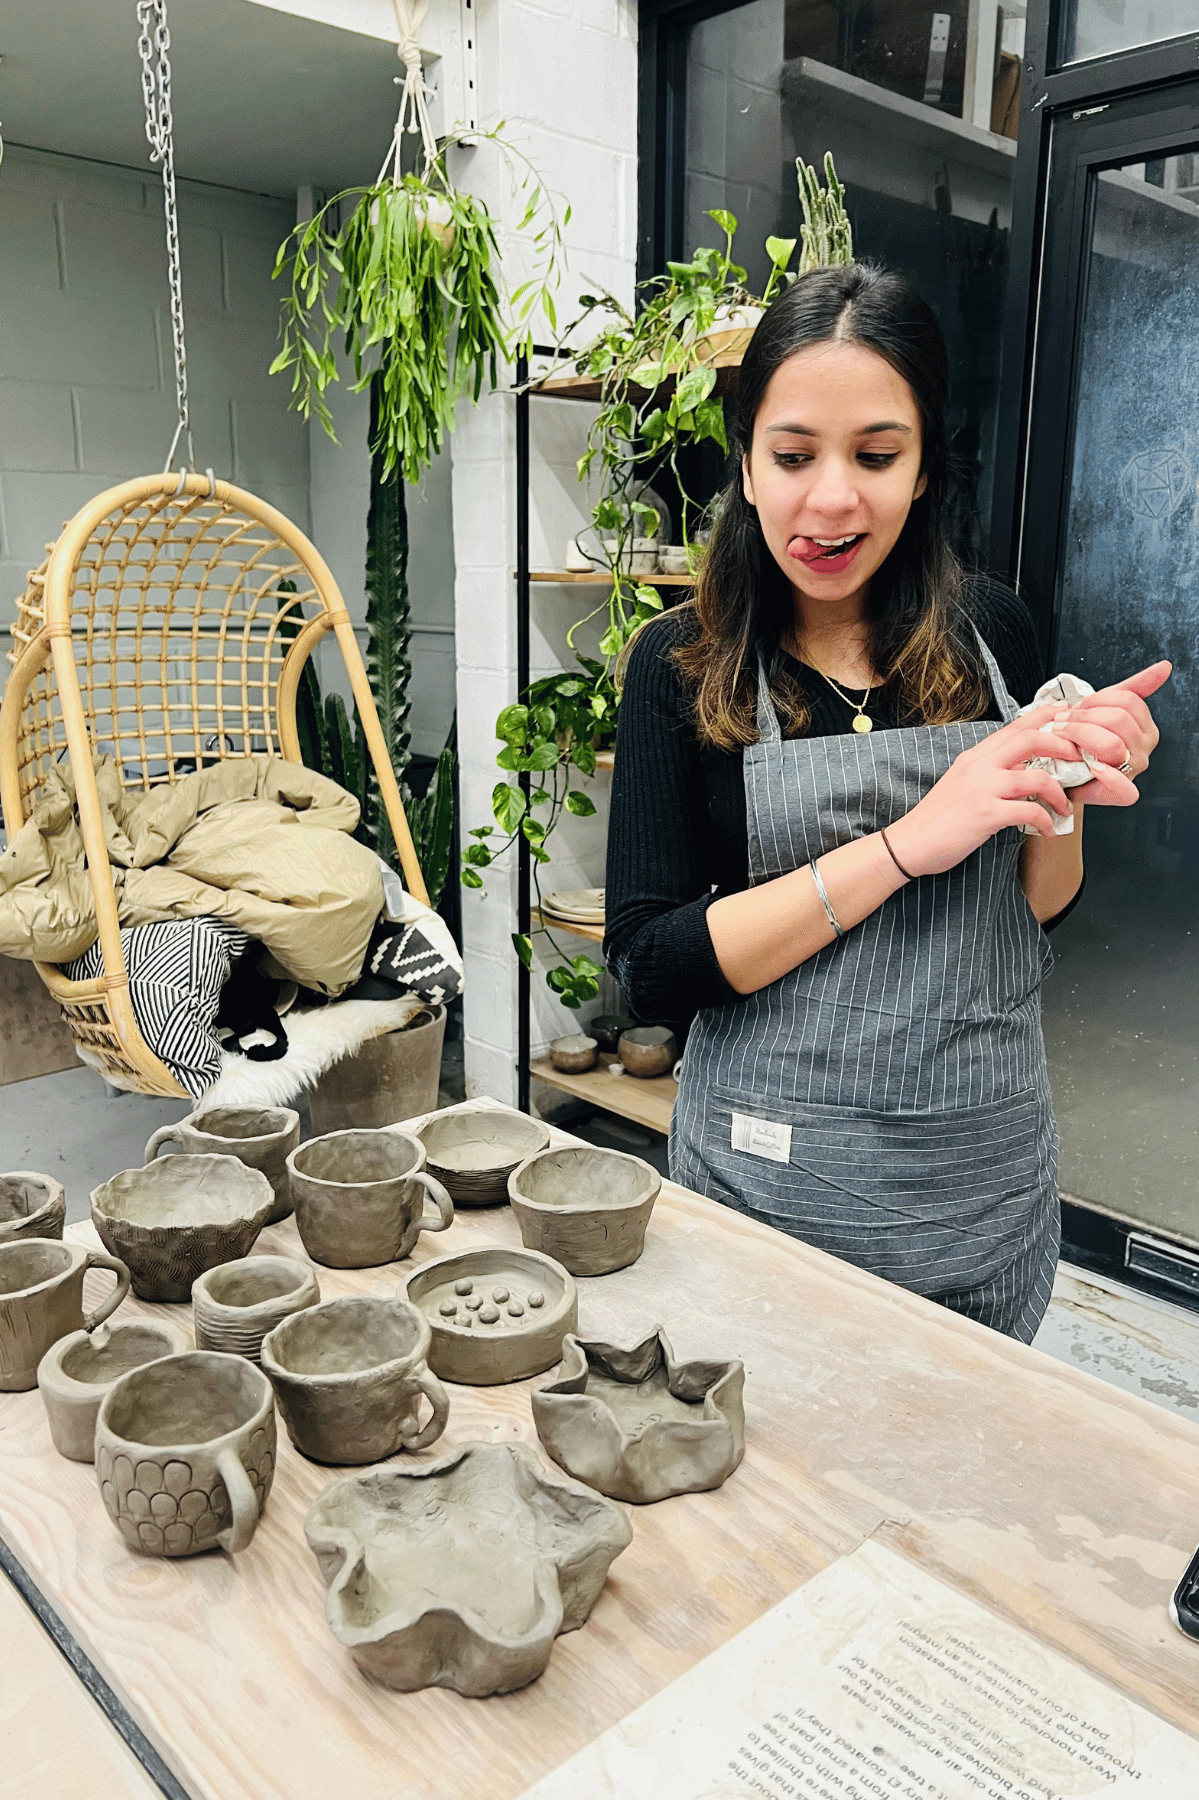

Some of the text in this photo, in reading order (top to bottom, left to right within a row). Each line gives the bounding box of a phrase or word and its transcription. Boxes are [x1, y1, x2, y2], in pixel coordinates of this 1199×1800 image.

[837, 1664, 859, 1680] our
[850, 1655, 869, 1670] for
[858, 1679, 873, 1693] to
[868, 1667, 899, 1689] jobs
[986, 1659, 1040, 1698] business
[840, 1684, 879, 1712] create
[894, 1685, 934, 1714] create
[896, 1619, 1142, 1780] through One Tree Planted as an integral
[1039, 1696, 1064, 1713] our
[771, 1712, 789, 1723] of
[873, 1688, 937, 1735] contribute
[898, 1635, 1117, 1784] We're honored to have reforestation
[1061, 1711, 1079, 1722] of
[788, 1721, 817, 1743] part
[794, 1707, 833, 1737] they'll
[931, 1713, 961, 1733] and
[1080, 1720, 1111, 1741] part
[747, 1732, 762, 1746] to
[762, 1722, 788, 1747] Tree
[984, 1729, 1025, 1759] social
[737, 1746, 771, 1773] gives
[788, 1742, 815, 1766] One
[812, 1742, 849, 1769] small
[916, 1739, 944, 1759] and
[727, 1761, 749, 1781] the
[759, 1743, 805, 1780] thrilled
[849, 1767, 859, 1776] a
[943, 1758, 963, 1771] air
[768, 1771, 795, 1795] that
[815, 1763, 844, 1789] with
[899, 1764, 926, 1787] tree
[962, 1772, 987, 1790] our
[927, 1784, 937, 1793] a
